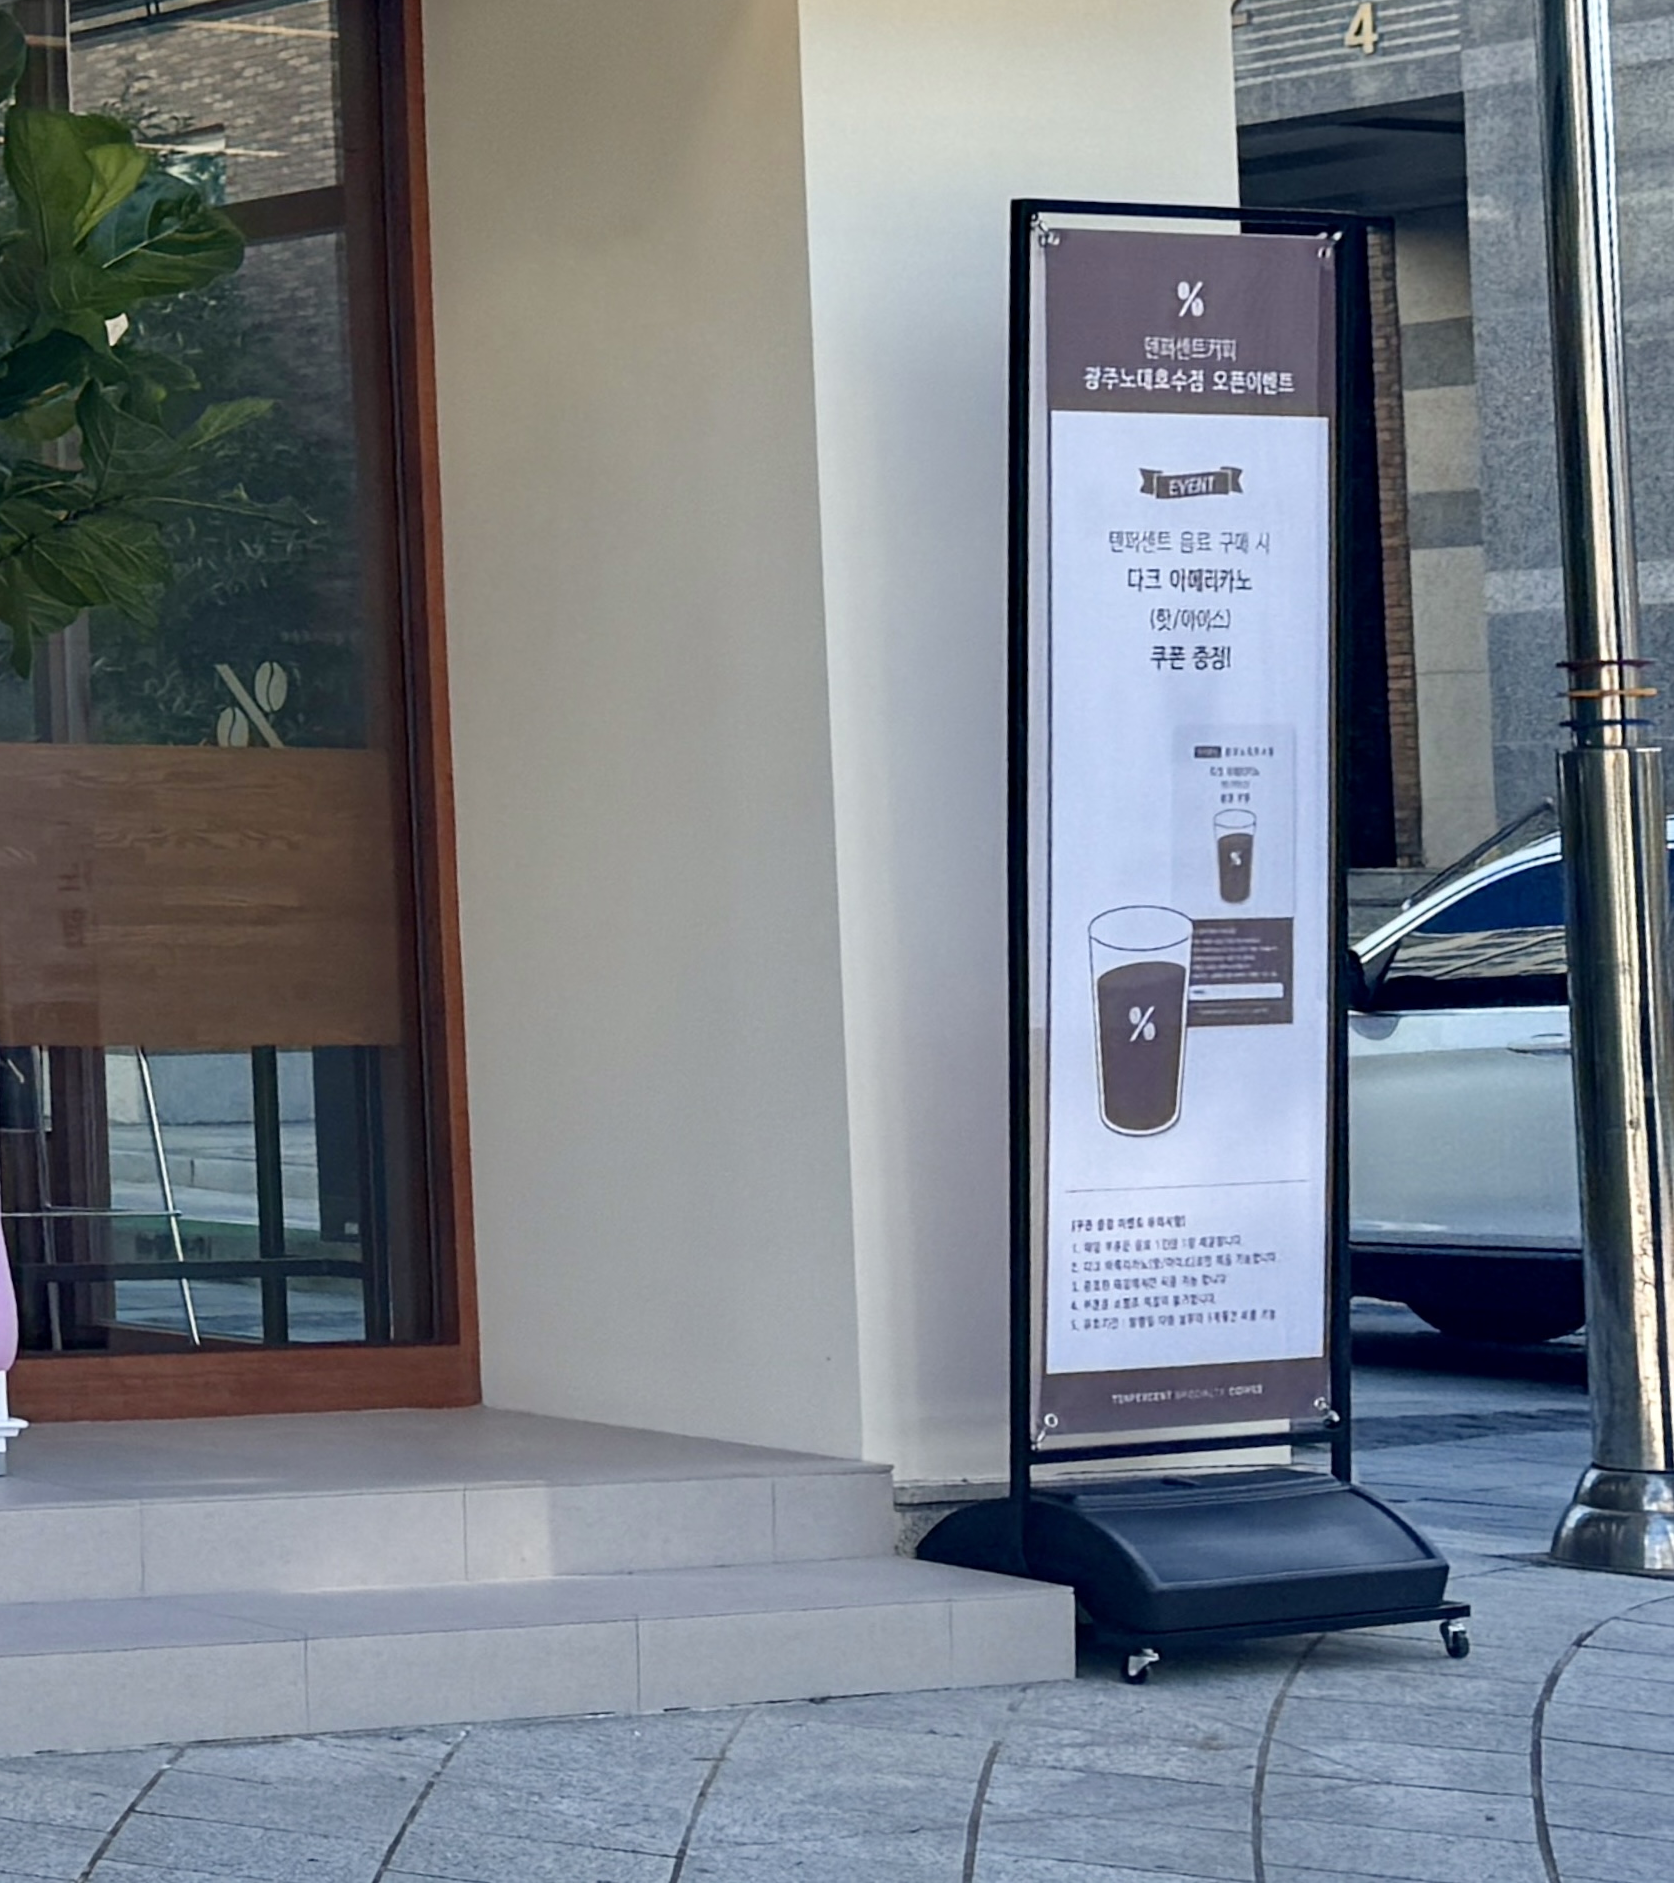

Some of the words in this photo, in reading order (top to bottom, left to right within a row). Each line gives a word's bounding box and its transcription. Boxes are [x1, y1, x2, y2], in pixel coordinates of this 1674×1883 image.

[1343, 1, 1378, 55] 4
[1144, 336, 1237, 361] 텐퍼센트커피
[1083, 366, 1204, 393] 광주노대호수점
[1212, 370, 1295, 395] 오픈이벤트
[1169, 475, 1216, 497] EVENT
[1109, 531, 1173, 553] 텐퍼센트
[1180, 531, 1212, 554] 음료
[1219, 532, 1249, 555] 구매
[1255, 532, 1270, 555] 시
[1127, 568, 1162, 592] 다크
[1169, 568, 1253, 593] 아메리카노
[1150, 645, 1186, 671] 쿠폰
[1192, 645, 1232, 671] 증정!
